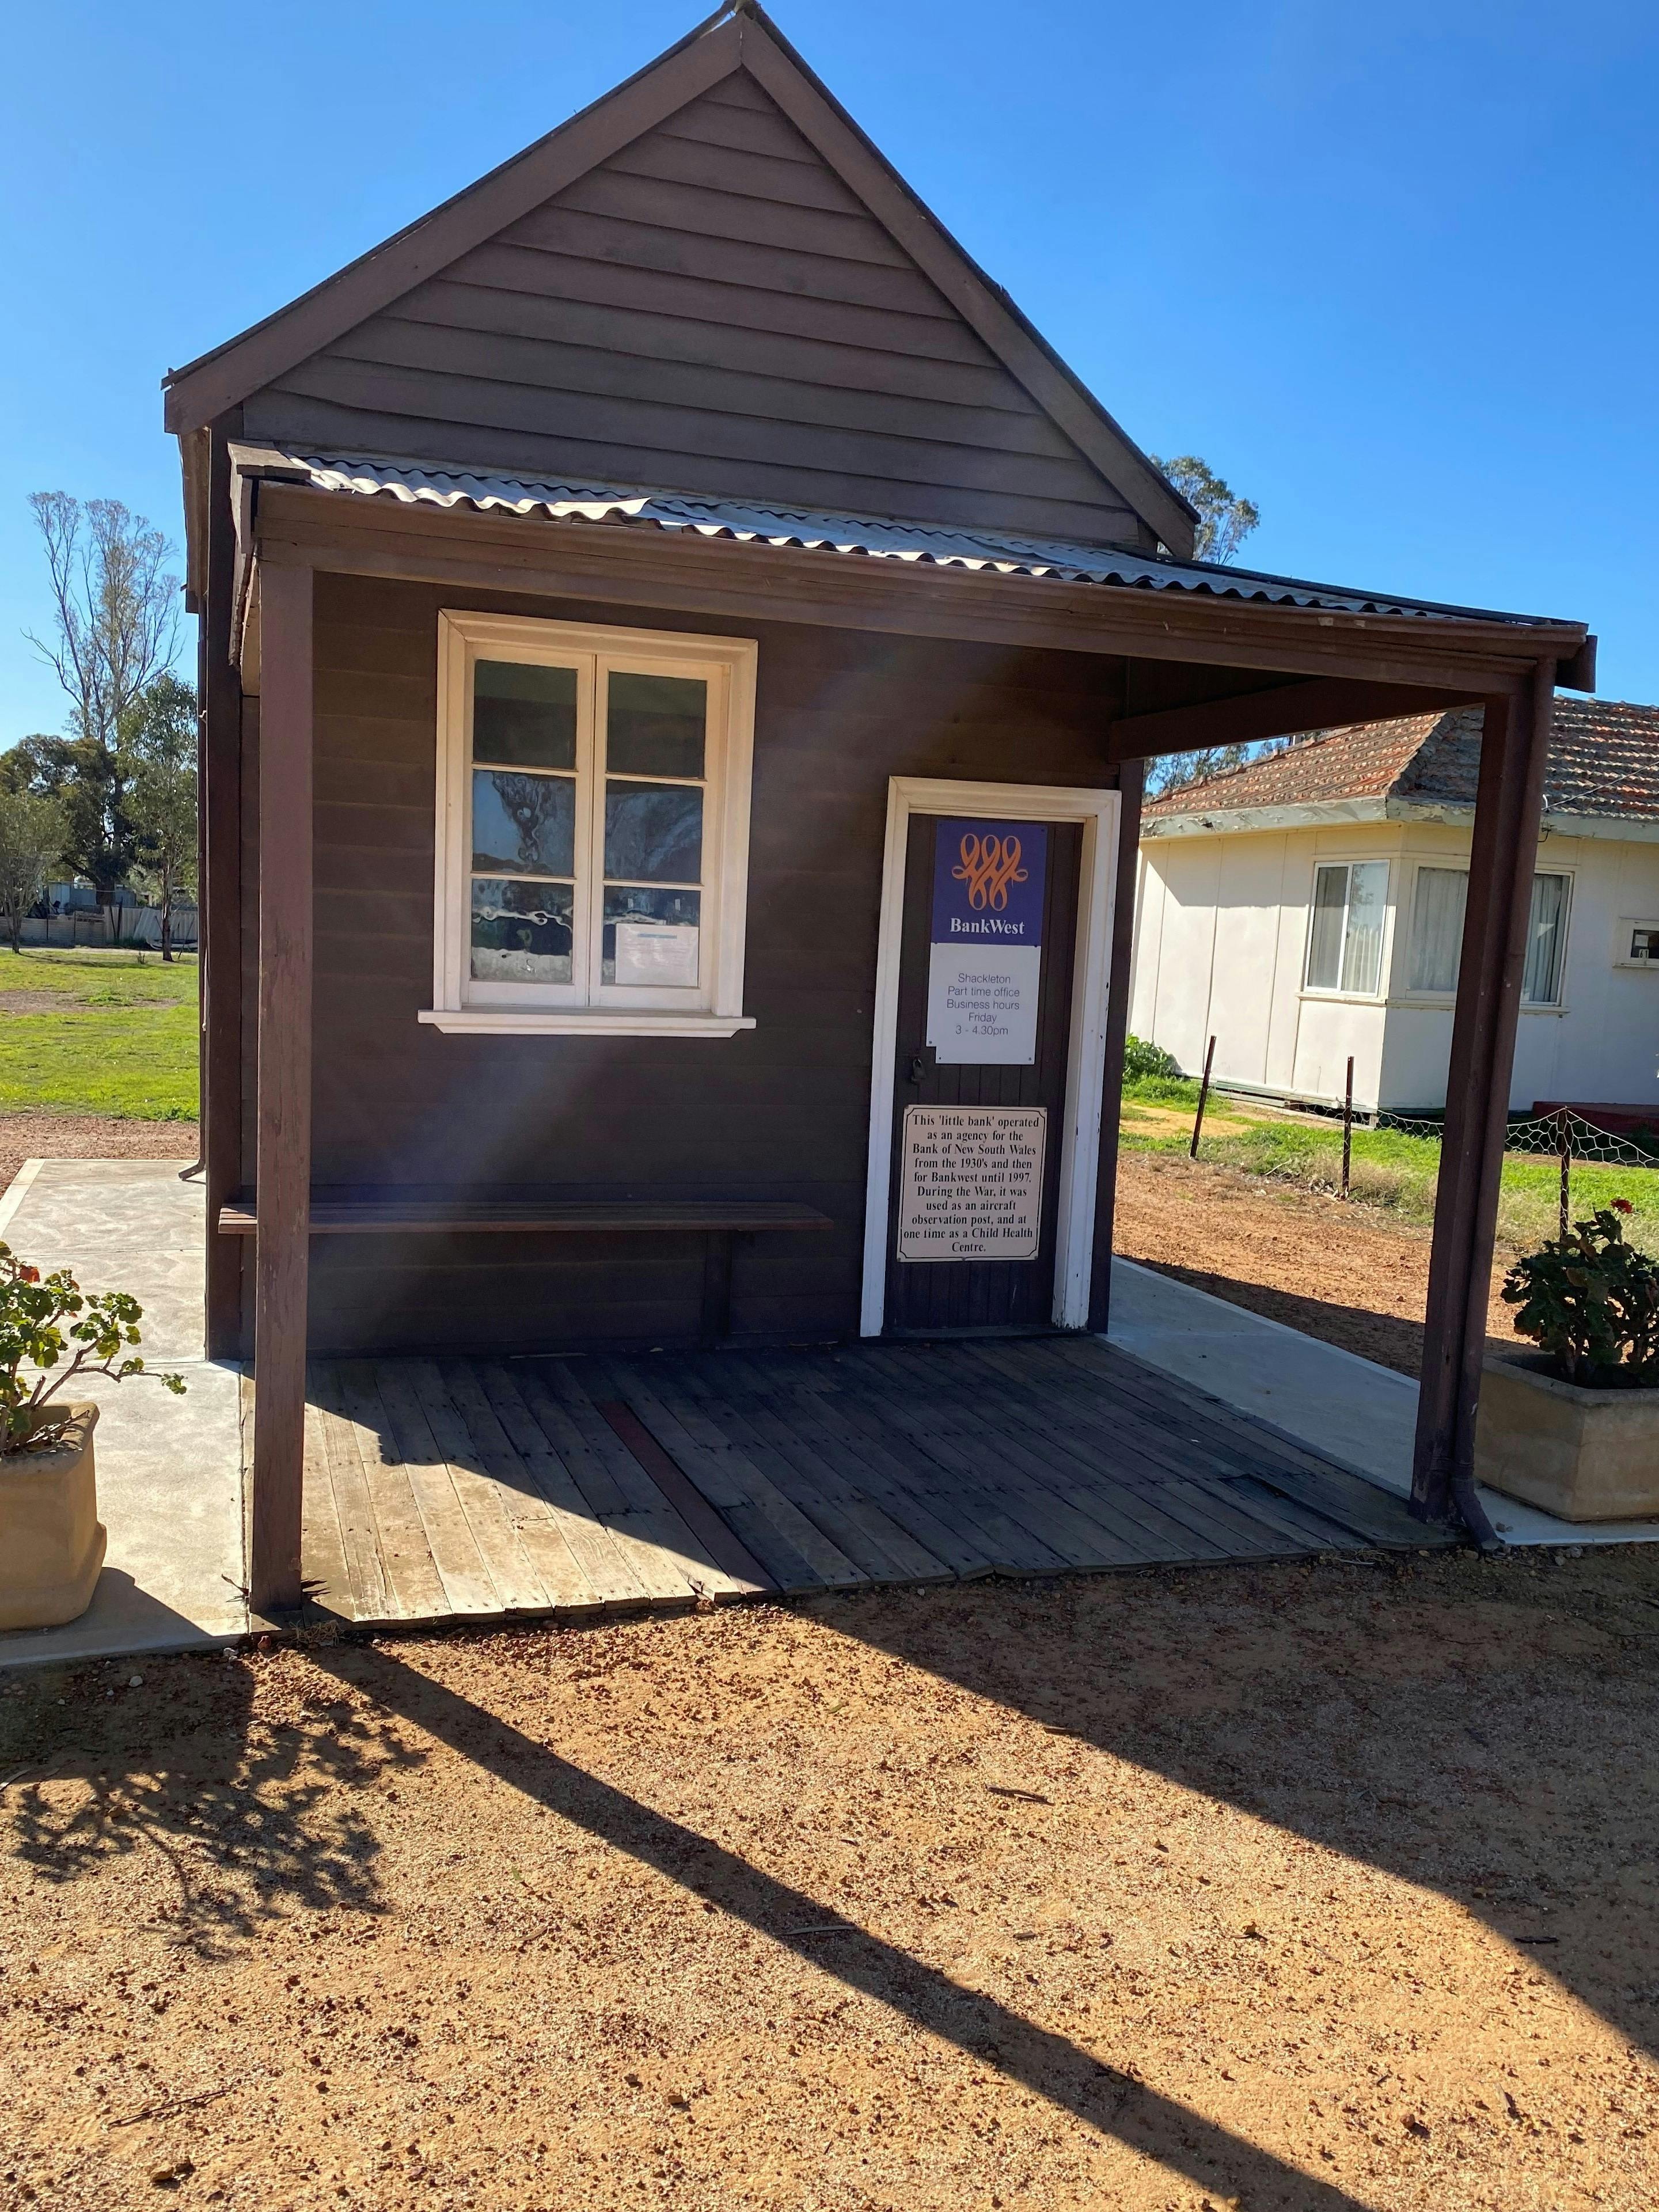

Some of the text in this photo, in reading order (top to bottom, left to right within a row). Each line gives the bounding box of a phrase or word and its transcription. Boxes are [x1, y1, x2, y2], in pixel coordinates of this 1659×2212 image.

[950, 917, 1025, 936] BankWest
[958, 972, 1011, 985] Shackleton
[948, 986, 1020, 997] Part time office
[946, 999, 1020, 1010] Business hours
[969, 1012, 997, 1024] Friday
[955, 1026, 962, 1035] 3
[912, 1115, 1039, 1129] This 'little bank' operated
[927, 1131, 1023, 1143] as an agency for the
[913, 1144, 1037, 1155] Bank of New South Wales
[914, 1158, 1032, 1169] from the 1930's and then
[914, 1172, 1031, 1183] for Bankwest until 1997.
[917, 1186, 1027, 1198] During the War, it was
[926, 1201, 948, 1211] used
[980, 1200, 1016, 1211] aircraft
[912, 1214, 1027, 1227] observation post, and at
[903, 1228, 1032, 1239] one time as a Child Health
[952, 1242, 986, 1252] Centre.
